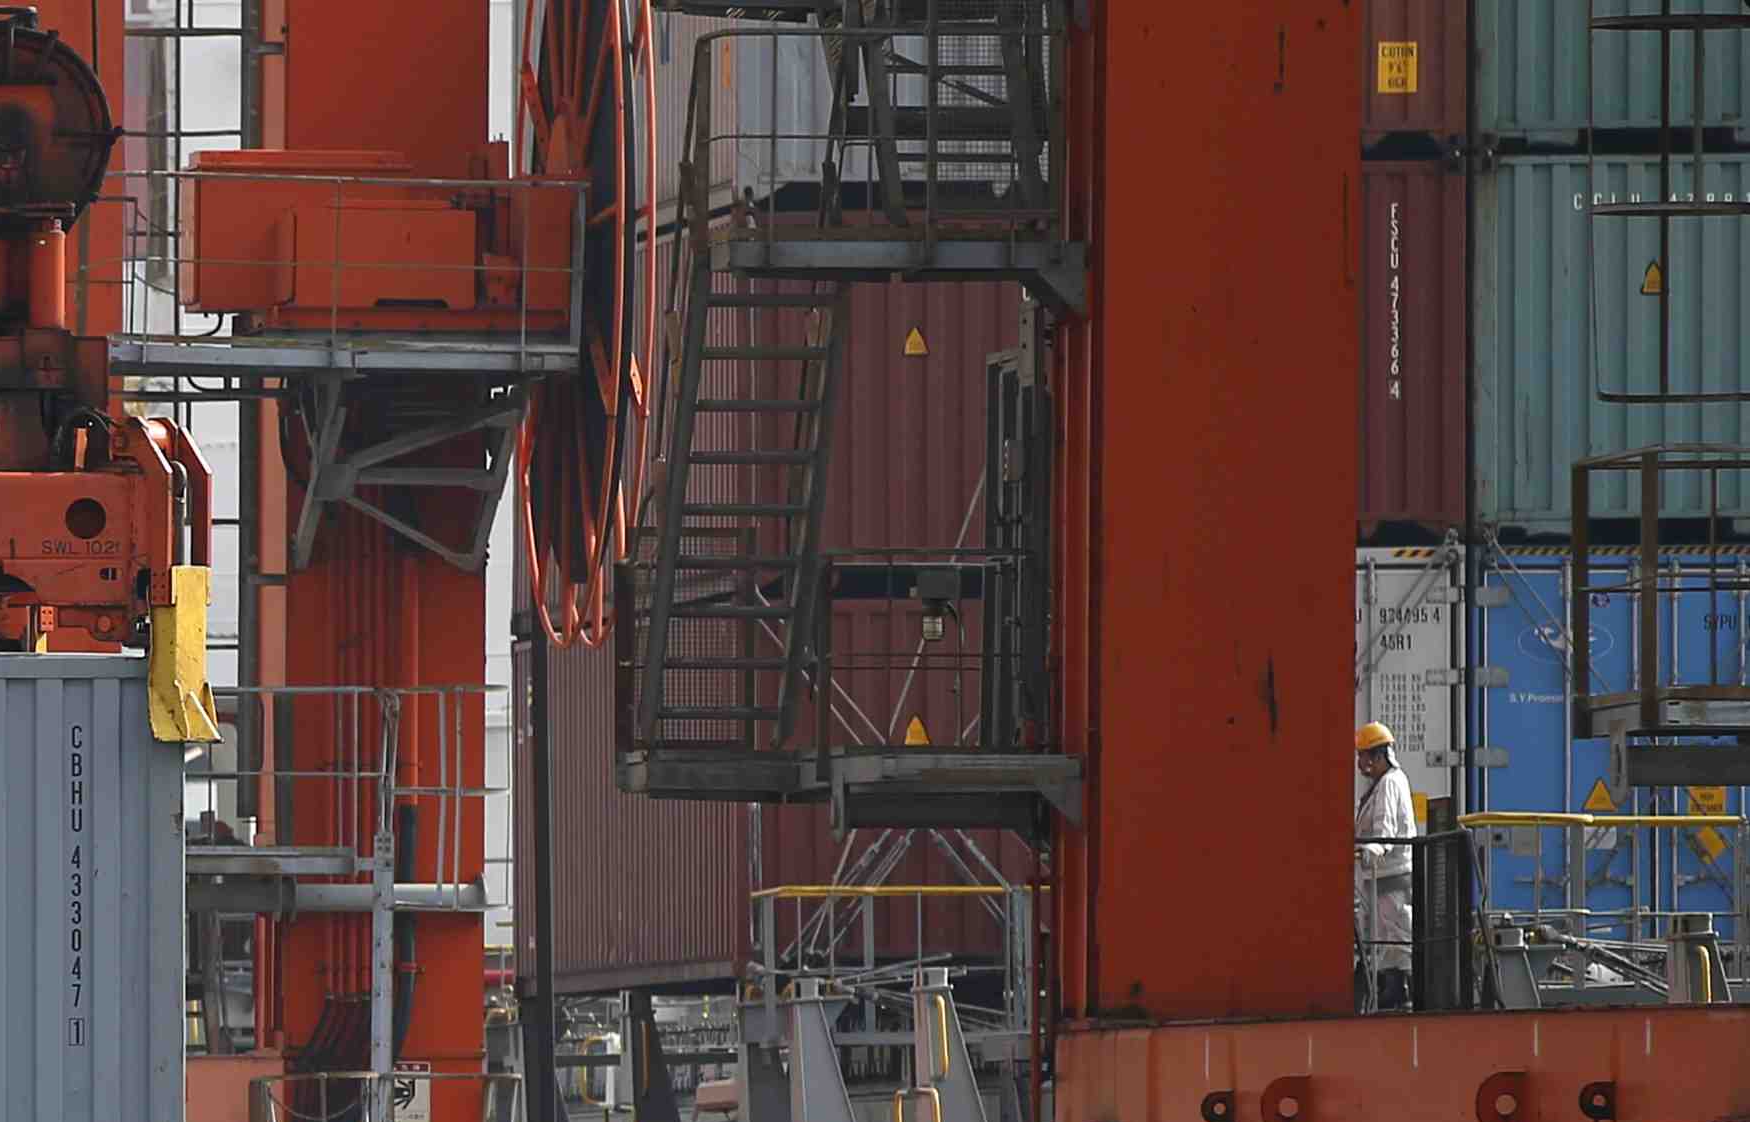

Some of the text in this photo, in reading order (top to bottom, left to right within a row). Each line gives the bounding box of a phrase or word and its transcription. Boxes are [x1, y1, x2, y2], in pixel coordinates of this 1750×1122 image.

[1389, 202, 1400, 400] FSCU 473366 4
[42, 539, 81, 555] SWL
[70, 725, 83, 832] CBHU
[70, 845, 83, 1008] 433047
